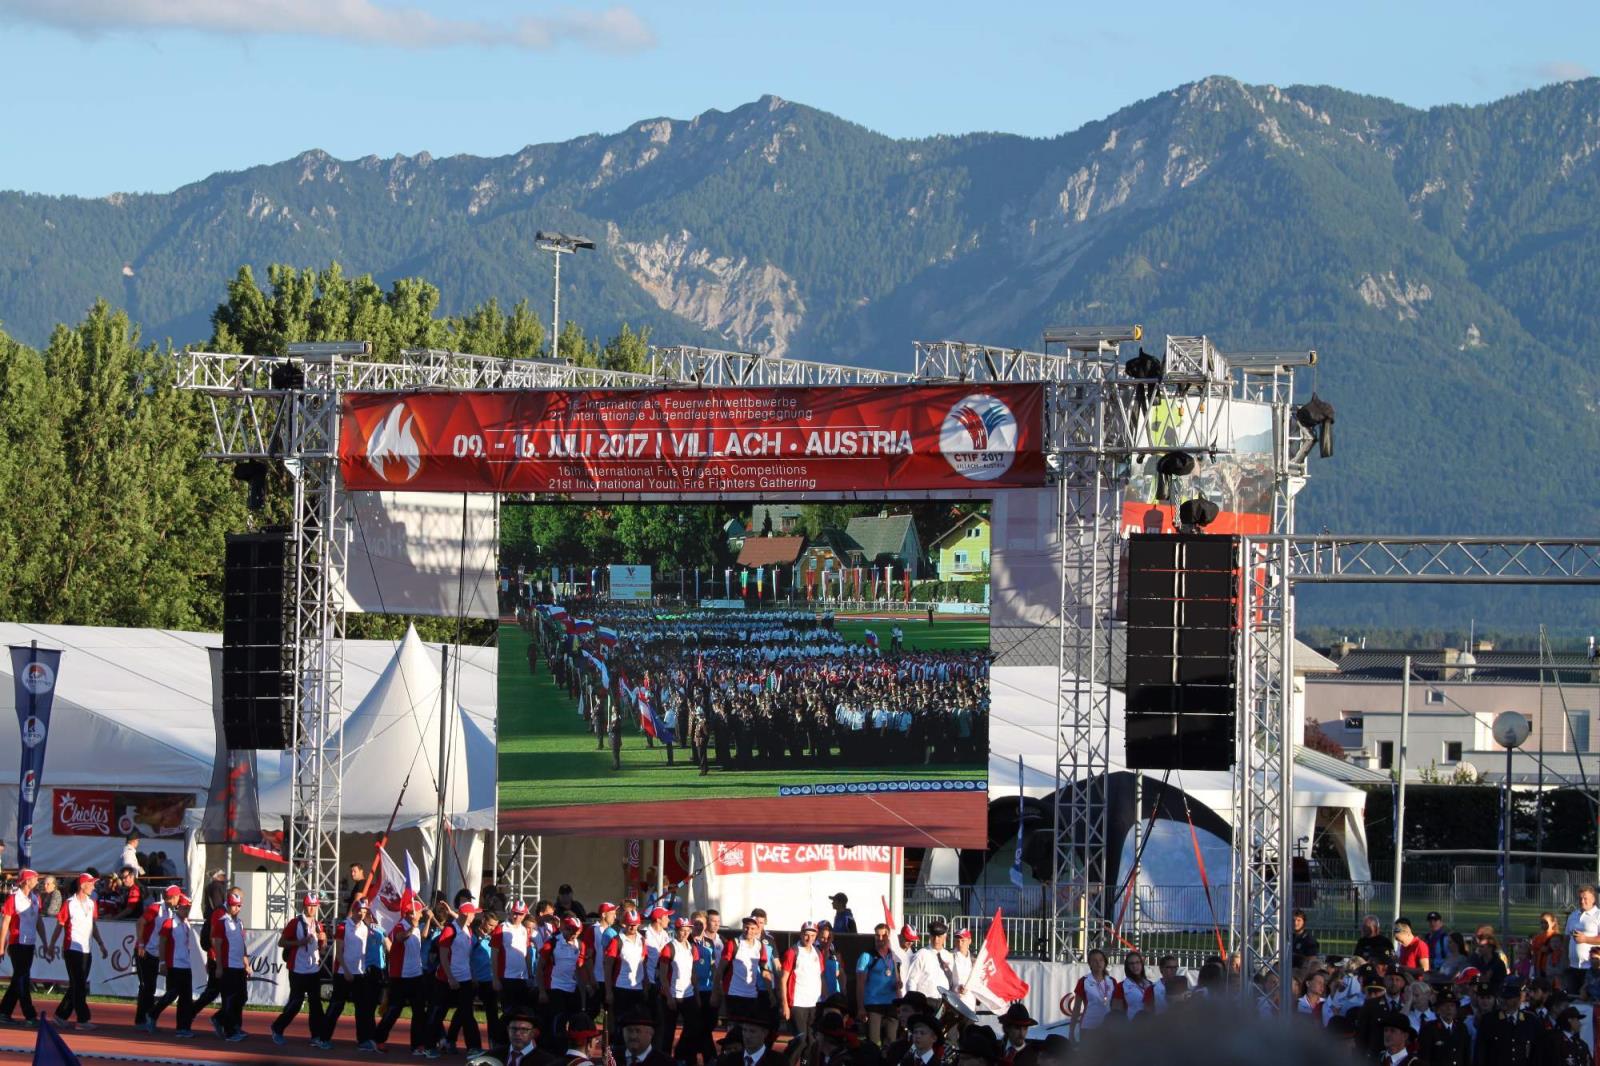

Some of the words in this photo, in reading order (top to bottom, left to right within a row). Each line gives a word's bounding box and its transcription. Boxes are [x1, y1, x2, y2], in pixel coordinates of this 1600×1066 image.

[585, 399, 660, 410] Internationale
[665, 397, 797, 409] Feuerwehrwettbewerbe
[571, 410, 645, 421] Internationale
[649, 409, 813, 422] Jugendfeuerwehrbegegnung
[453, 434, 486, 458] 09.
[598, 433, 648, 458] 2017
[672, 432, 782, 456] VILLACH
[805, 430, 913, 455] AUSTRIA
[954, 453, 978, 462] CTIF
[981, 453, 1004, 461] 2017
[559, 465, 581, 477] 16th
[584, 465, 654, 477] International
[658, 465, 678, 477] Fire
[682, 465, 726, 478] Brigade
[730, 464, 807, 477] Competitions
[549, 478, 572, 489] 21st
[576, 477, 644, 490] International
[684, 478, 705, 489] Fire
[709, 477, 756, 490] Fighters
[760, 476, 816, 489] Gathering
[61, 802, 110, 835] Chickis
[838, 845, 891, 863] DRINKS
